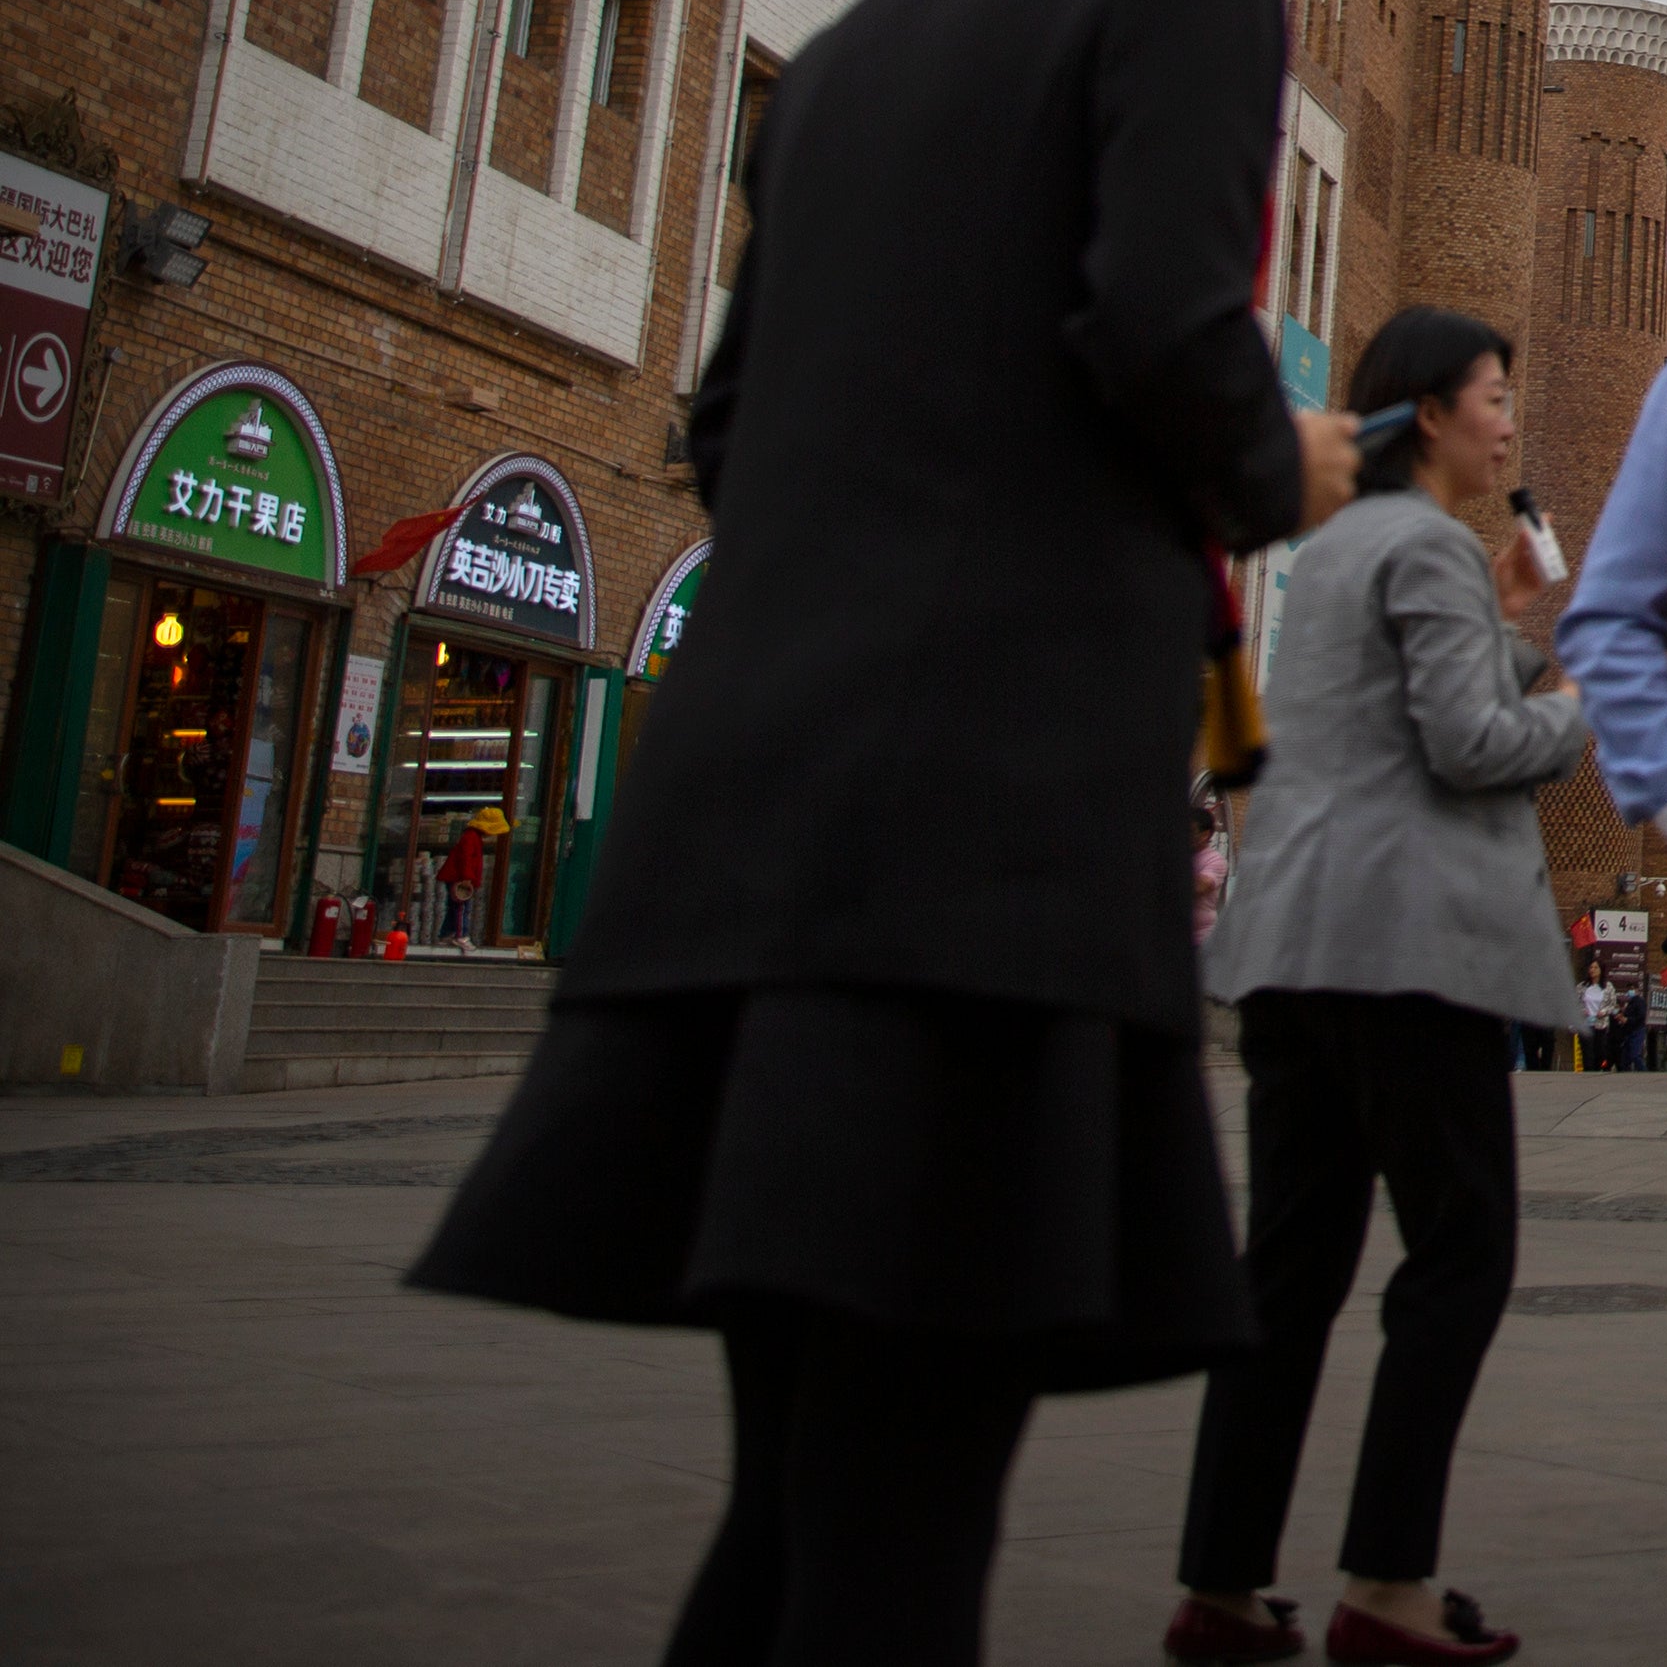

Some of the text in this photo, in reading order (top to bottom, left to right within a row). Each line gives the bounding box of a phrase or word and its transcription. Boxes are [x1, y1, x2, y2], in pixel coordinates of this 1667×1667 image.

[167, 469, 306, 545] 艾力干果店
[447, 537, 580, 614] 英吉沙小刀专卖
[1618, 915, 1627, 932] 4
